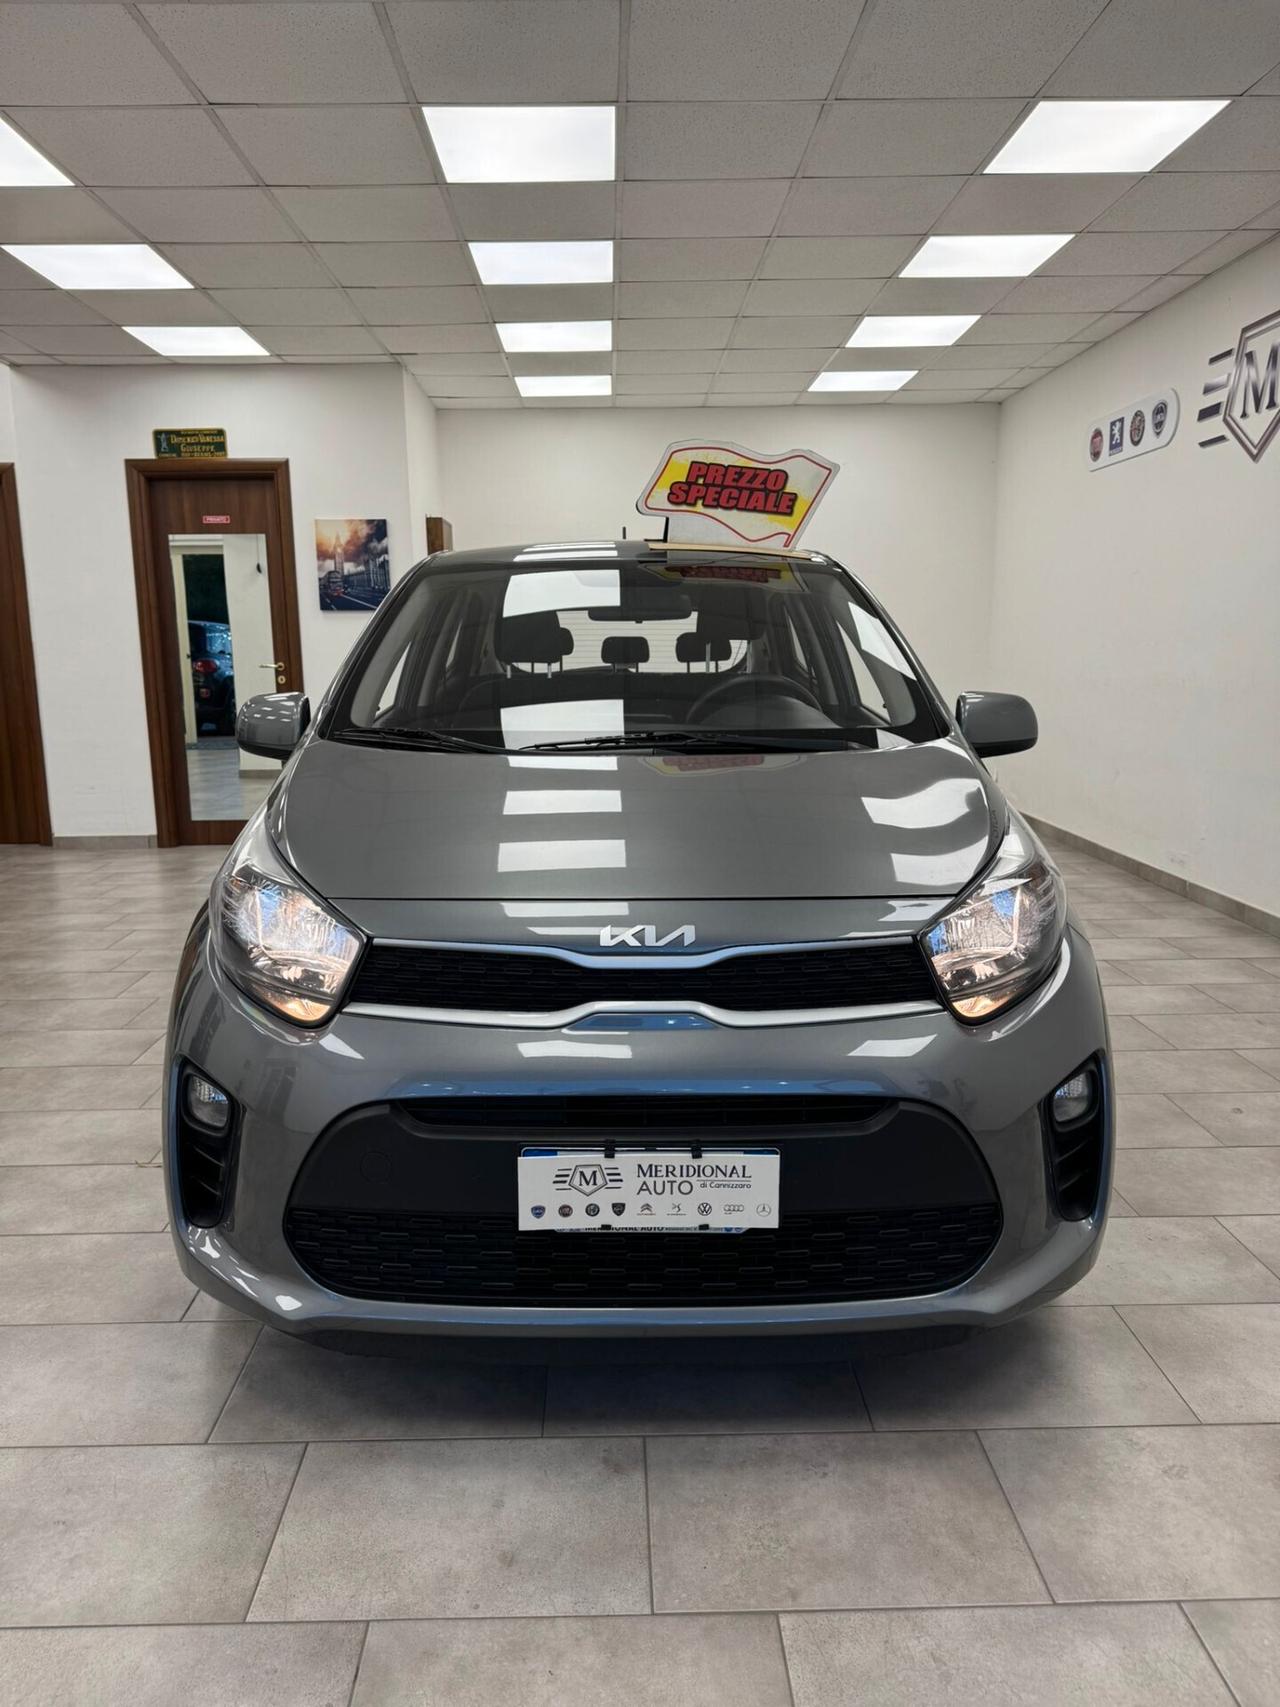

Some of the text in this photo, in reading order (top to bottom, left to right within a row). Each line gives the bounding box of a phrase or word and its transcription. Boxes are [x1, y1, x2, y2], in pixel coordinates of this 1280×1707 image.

[1240, 344, 1280, 418] M
[686, 461, 788, 493] PREZZO
[667, 481, 797, 517] SPECIALE
[600, 925, 695, 947] KIA
[578, 1170, 597, 1187] M
[637, 1164, 752, 1179] MERIDIONAL
[636, 1180, 694, 1196] AUTO
[699, 1182, 752, 1190] di Cannizzaro
